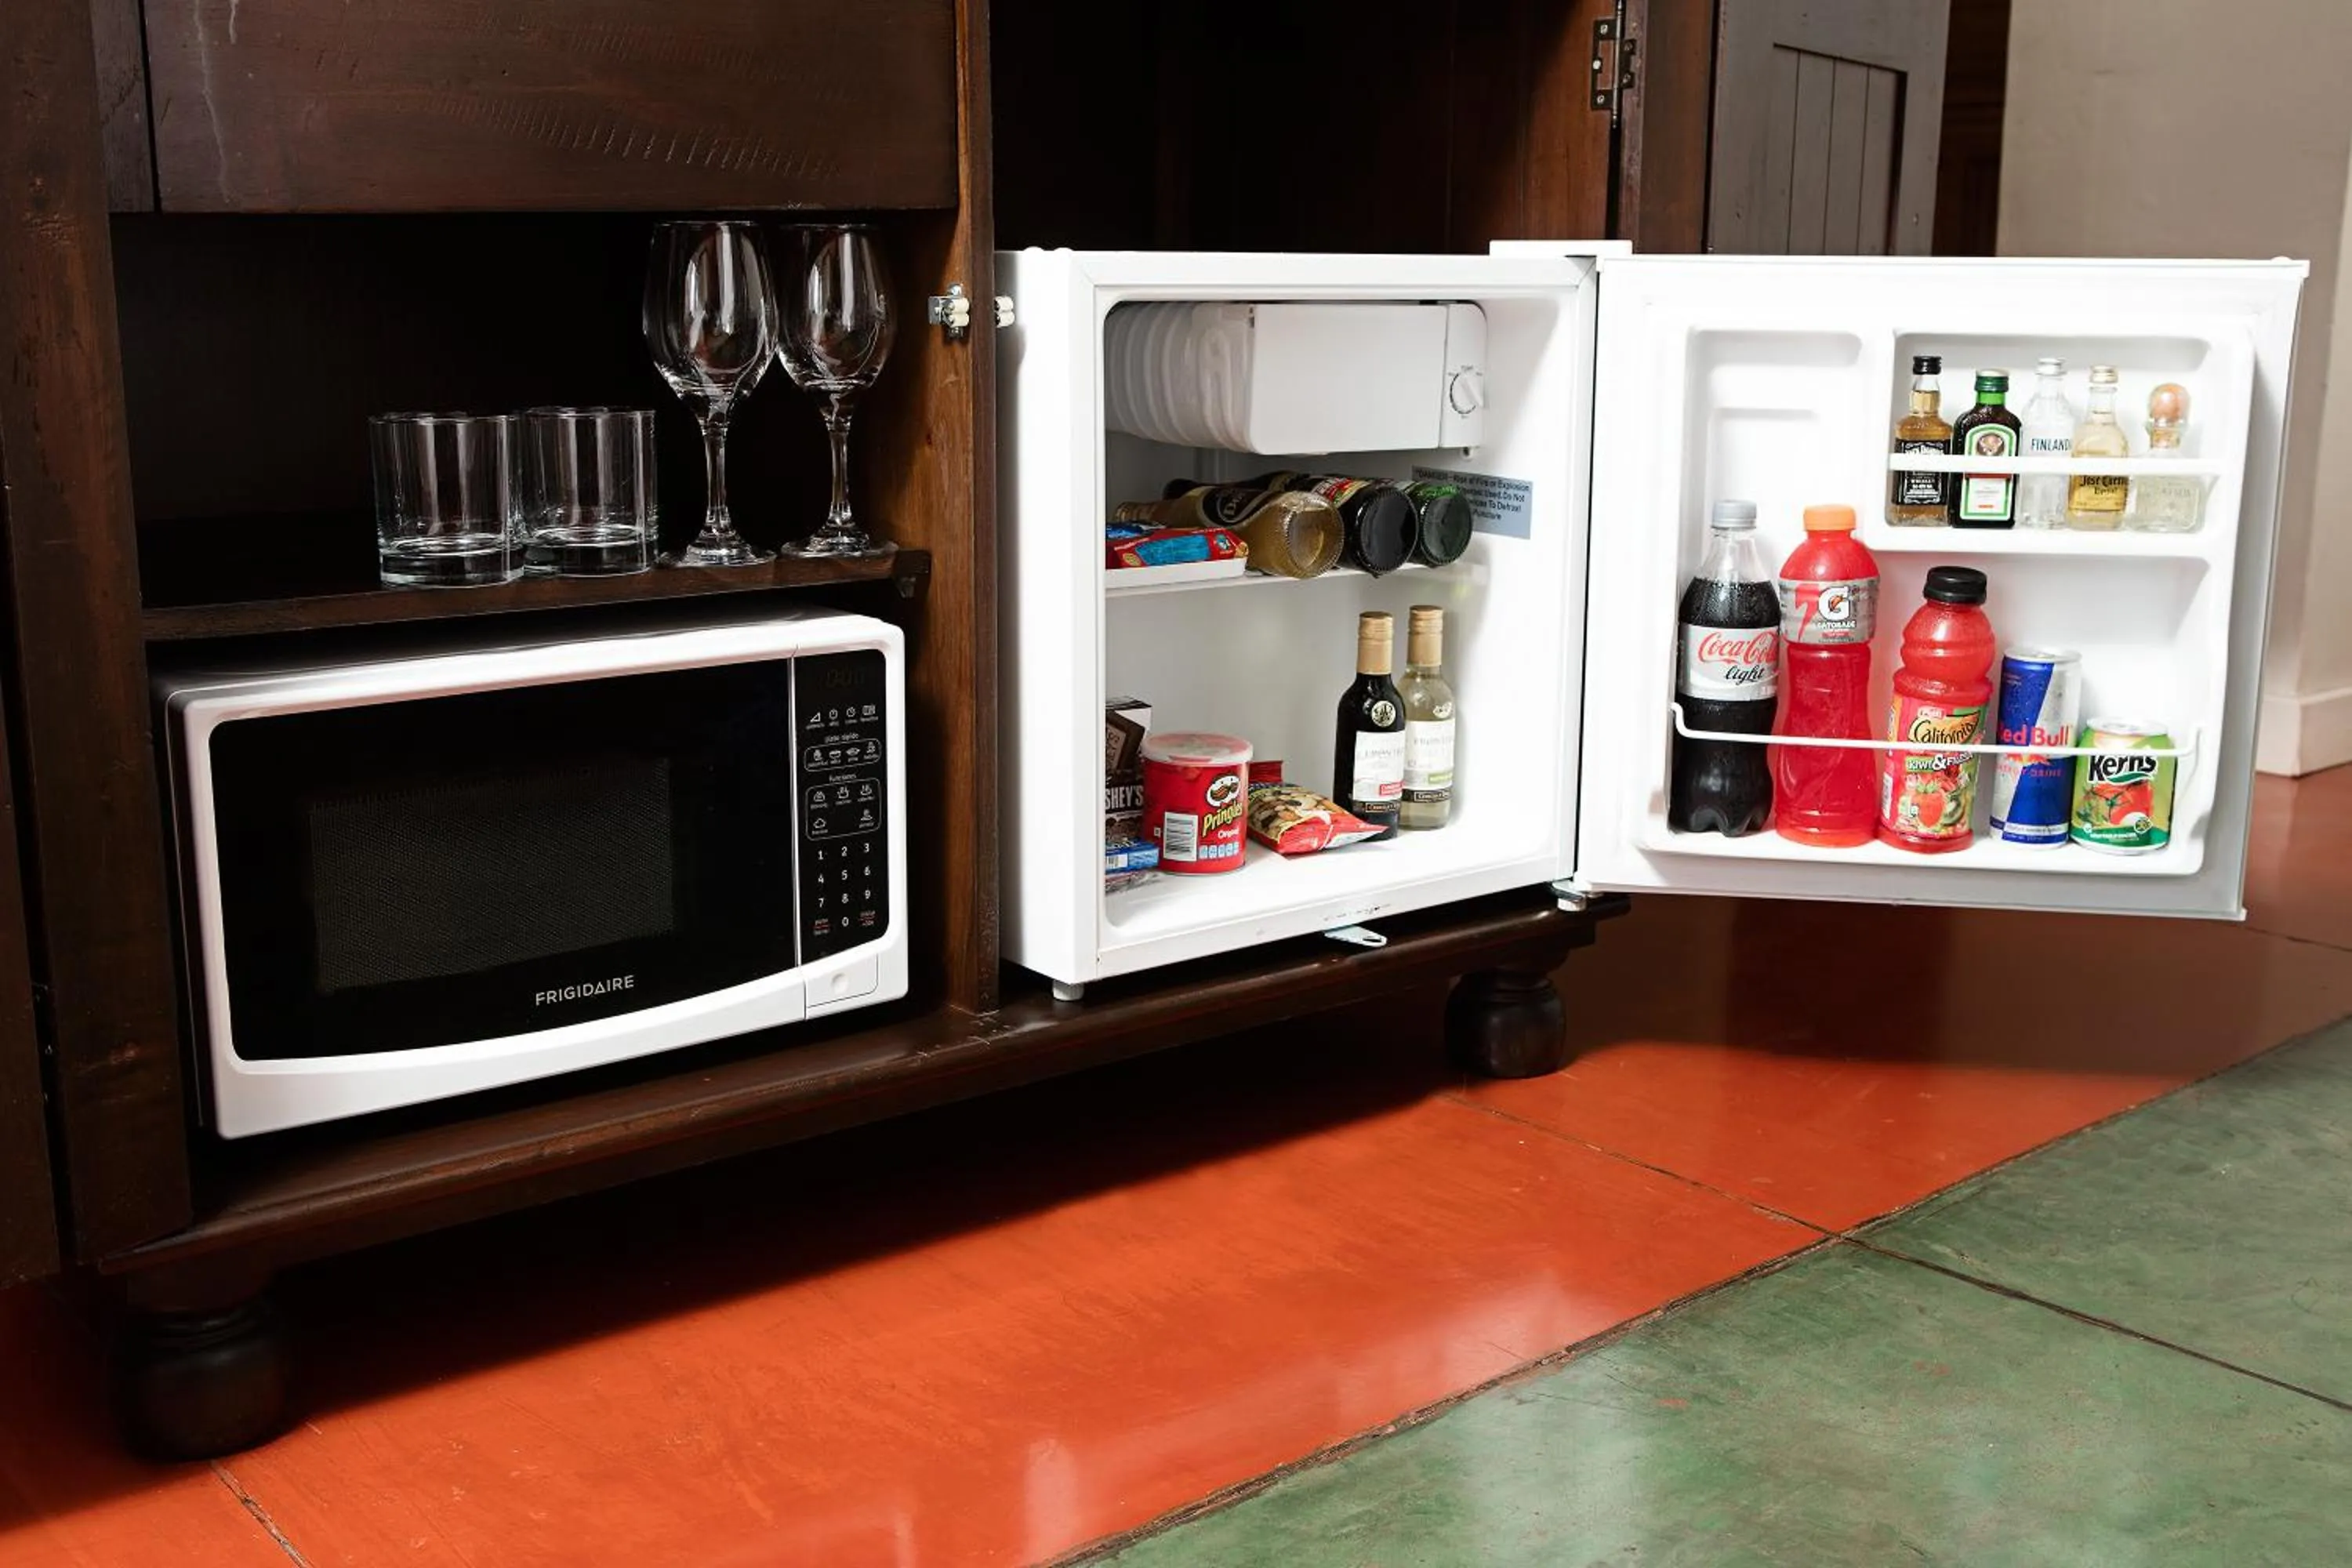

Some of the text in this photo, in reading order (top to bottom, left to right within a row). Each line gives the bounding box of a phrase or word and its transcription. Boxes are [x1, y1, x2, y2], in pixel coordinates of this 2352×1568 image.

[1724, 665, 1765, 686] light
[1914, 718, 1976, 744] California
[2030, 724, 2070, 747] Bull
[1202, 800, 1243, 838] Pringles
[818, 843, 869, 860] 1 2 3
[818, 866, 870, 884] 4 5 6
[818, 889, 870, 908] 7 8 9
[841, 916, 849, 927] 0
[535, 975, 634, 1006] FRIGIDAIRE
